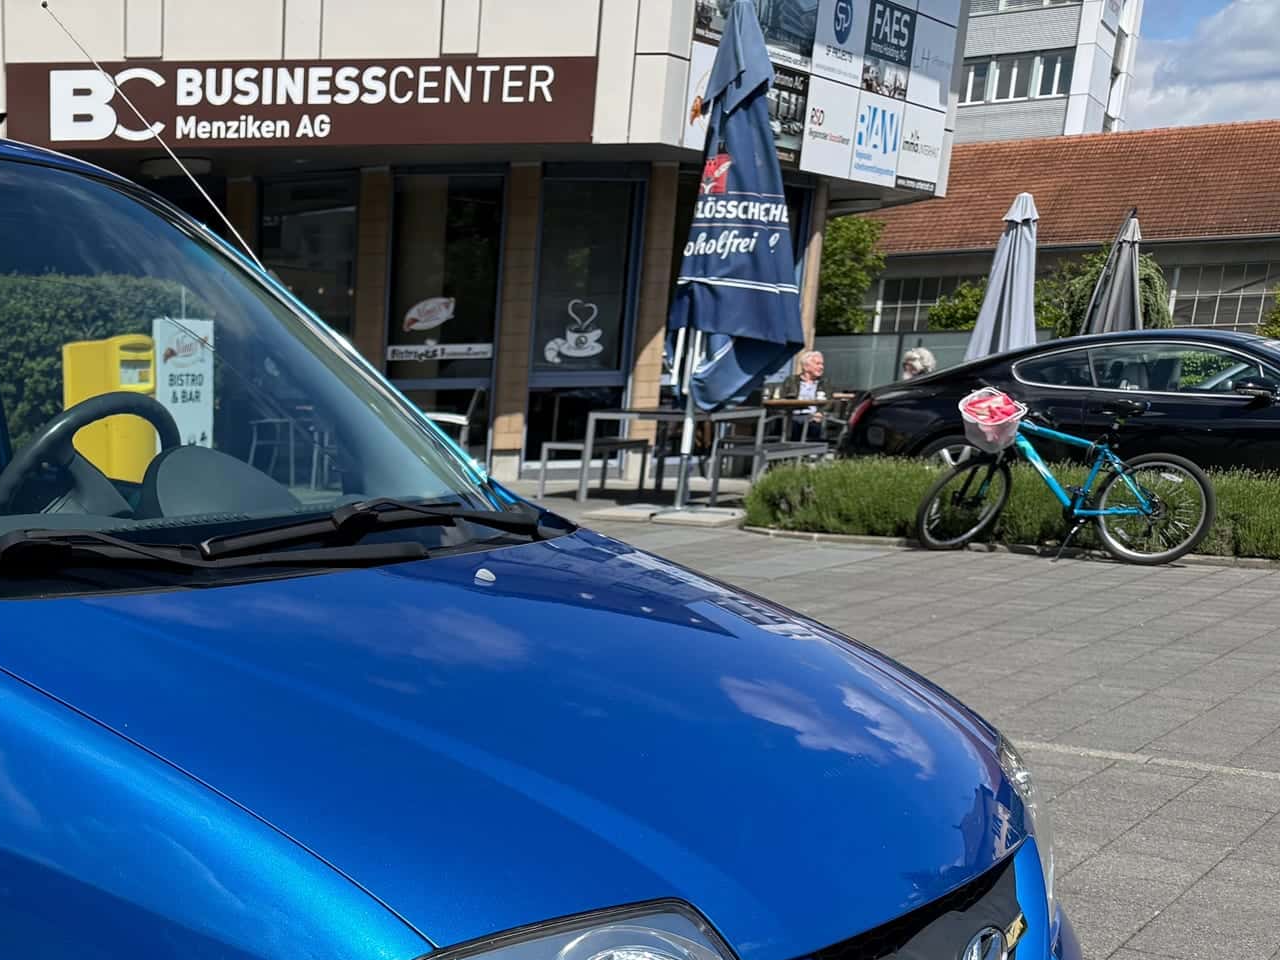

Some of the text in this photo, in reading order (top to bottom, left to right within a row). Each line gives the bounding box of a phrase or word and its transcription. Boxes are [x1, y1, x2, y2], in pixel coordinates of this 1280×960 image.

[871, 3, 911, 48] FAES
[176, 65, 554, 107] BUSINESSCENTER
[49, 67, 166, 142] BC
[176, 114, 332, 140] Menziken AG
[168, 373, 204, 387] BISTRO
[181, 391, 201, 404] BAR
